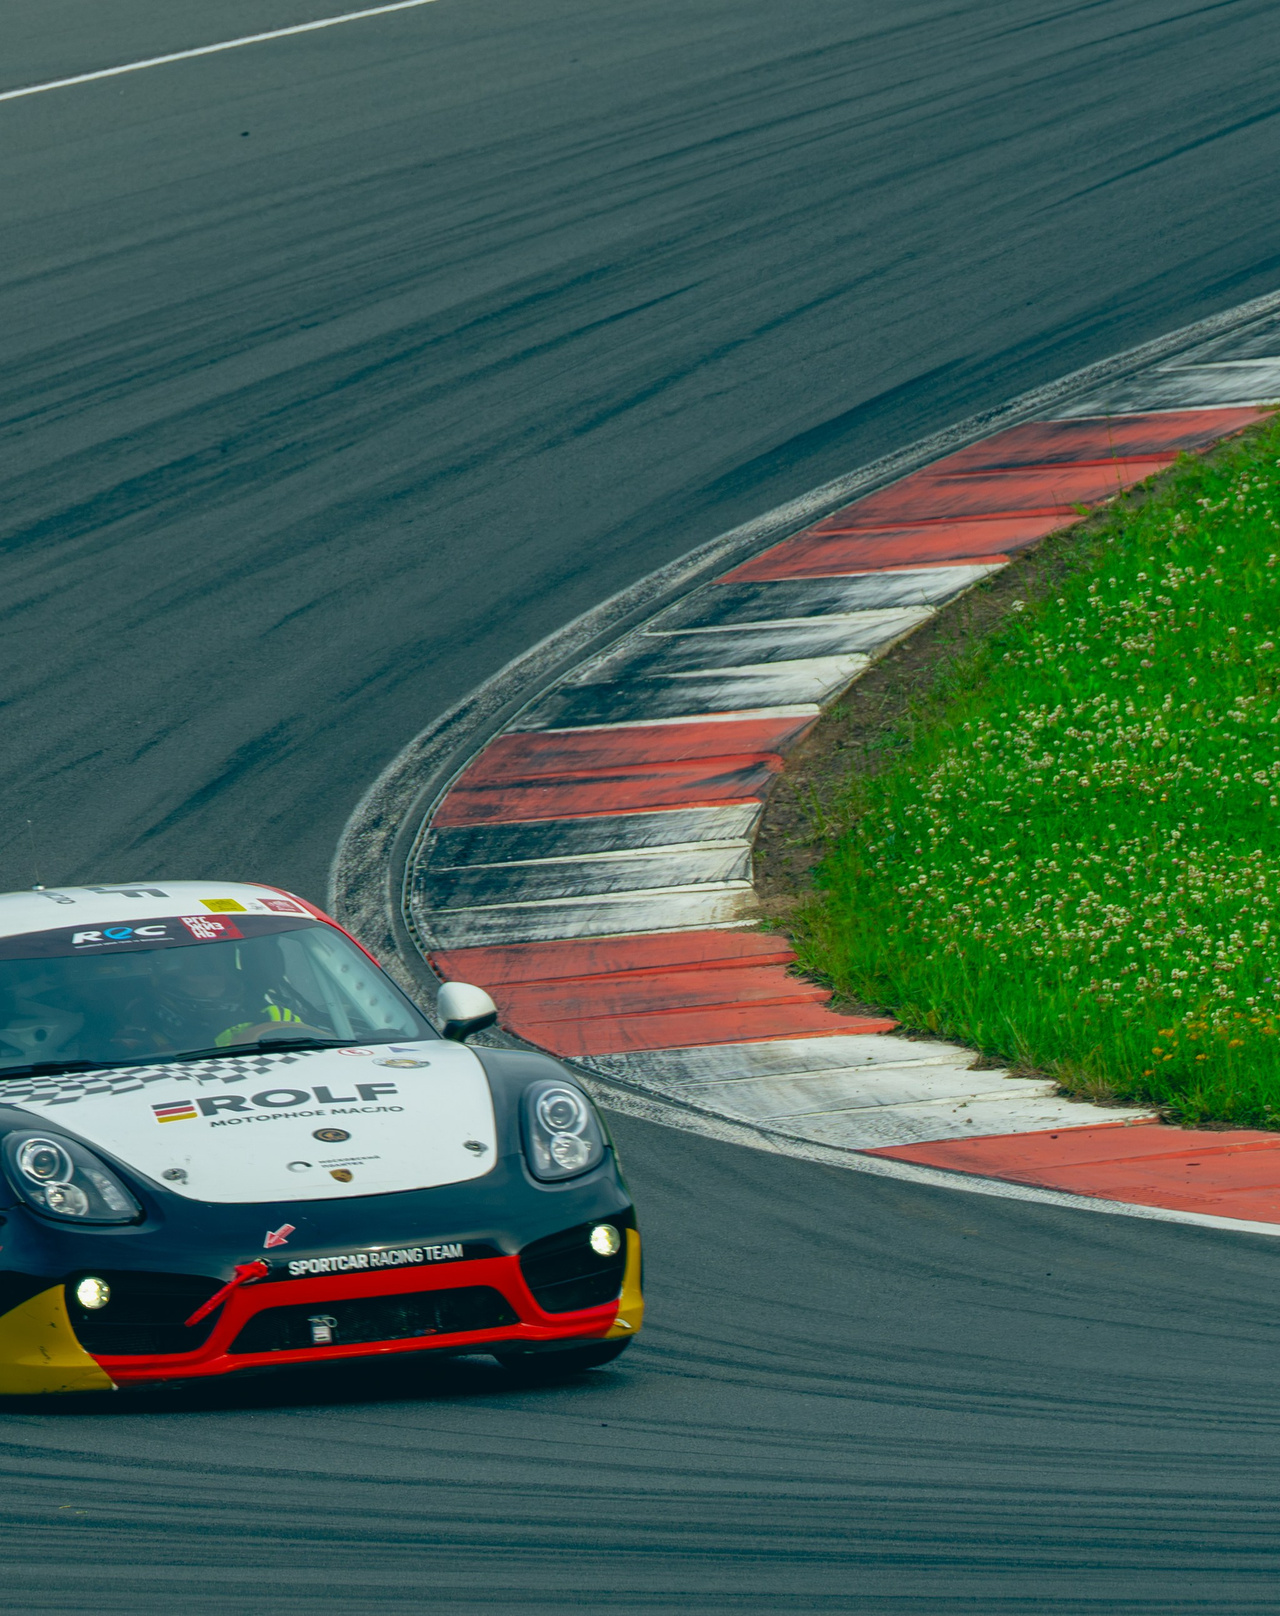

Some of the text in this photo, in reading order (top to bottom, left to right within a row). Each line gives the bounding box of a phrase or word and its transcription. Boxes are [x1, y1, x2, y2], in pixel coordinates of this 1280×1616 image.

[195, 1083, 398, 1117] ROLF
[210, 1105, 404, 1128] МОТОРНОЕ МАСЛО
[288, 1243, 464, 1276] SPORTCAR RACING TEAM
